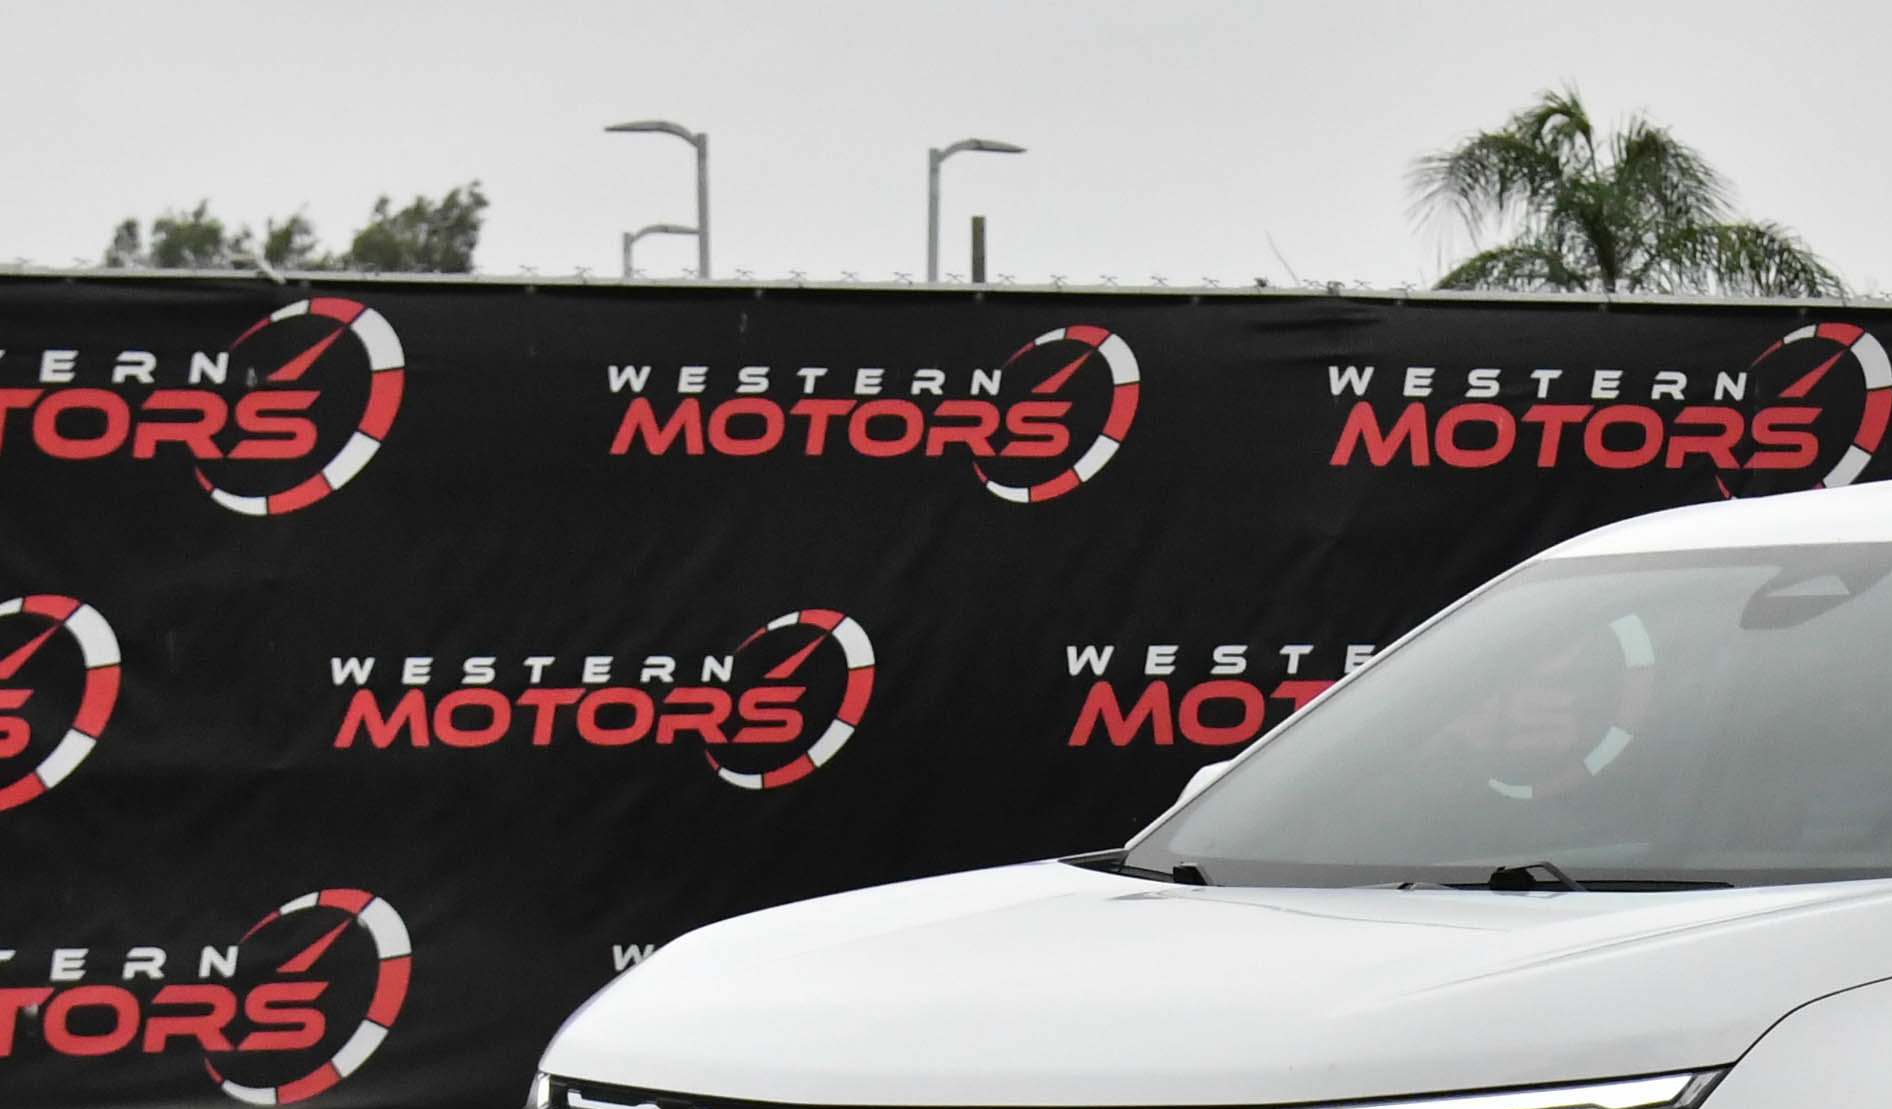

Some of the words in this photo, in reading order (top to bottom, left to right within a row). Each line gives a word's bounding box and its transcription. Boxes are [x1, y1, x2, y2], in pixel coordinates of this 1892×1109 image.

[0, 349, 230, 384] ERN
[608, 365, 1002, 396] WESTERN
[1328, 365, 1748, 401] WESTERN
[609, 397, 1073, 457] MOTORS
[1330, 401, 1822, 469] MOTORS
[330, 655, 734, 686] WESTERN
[333, 685, 807, 749] MOTORS
